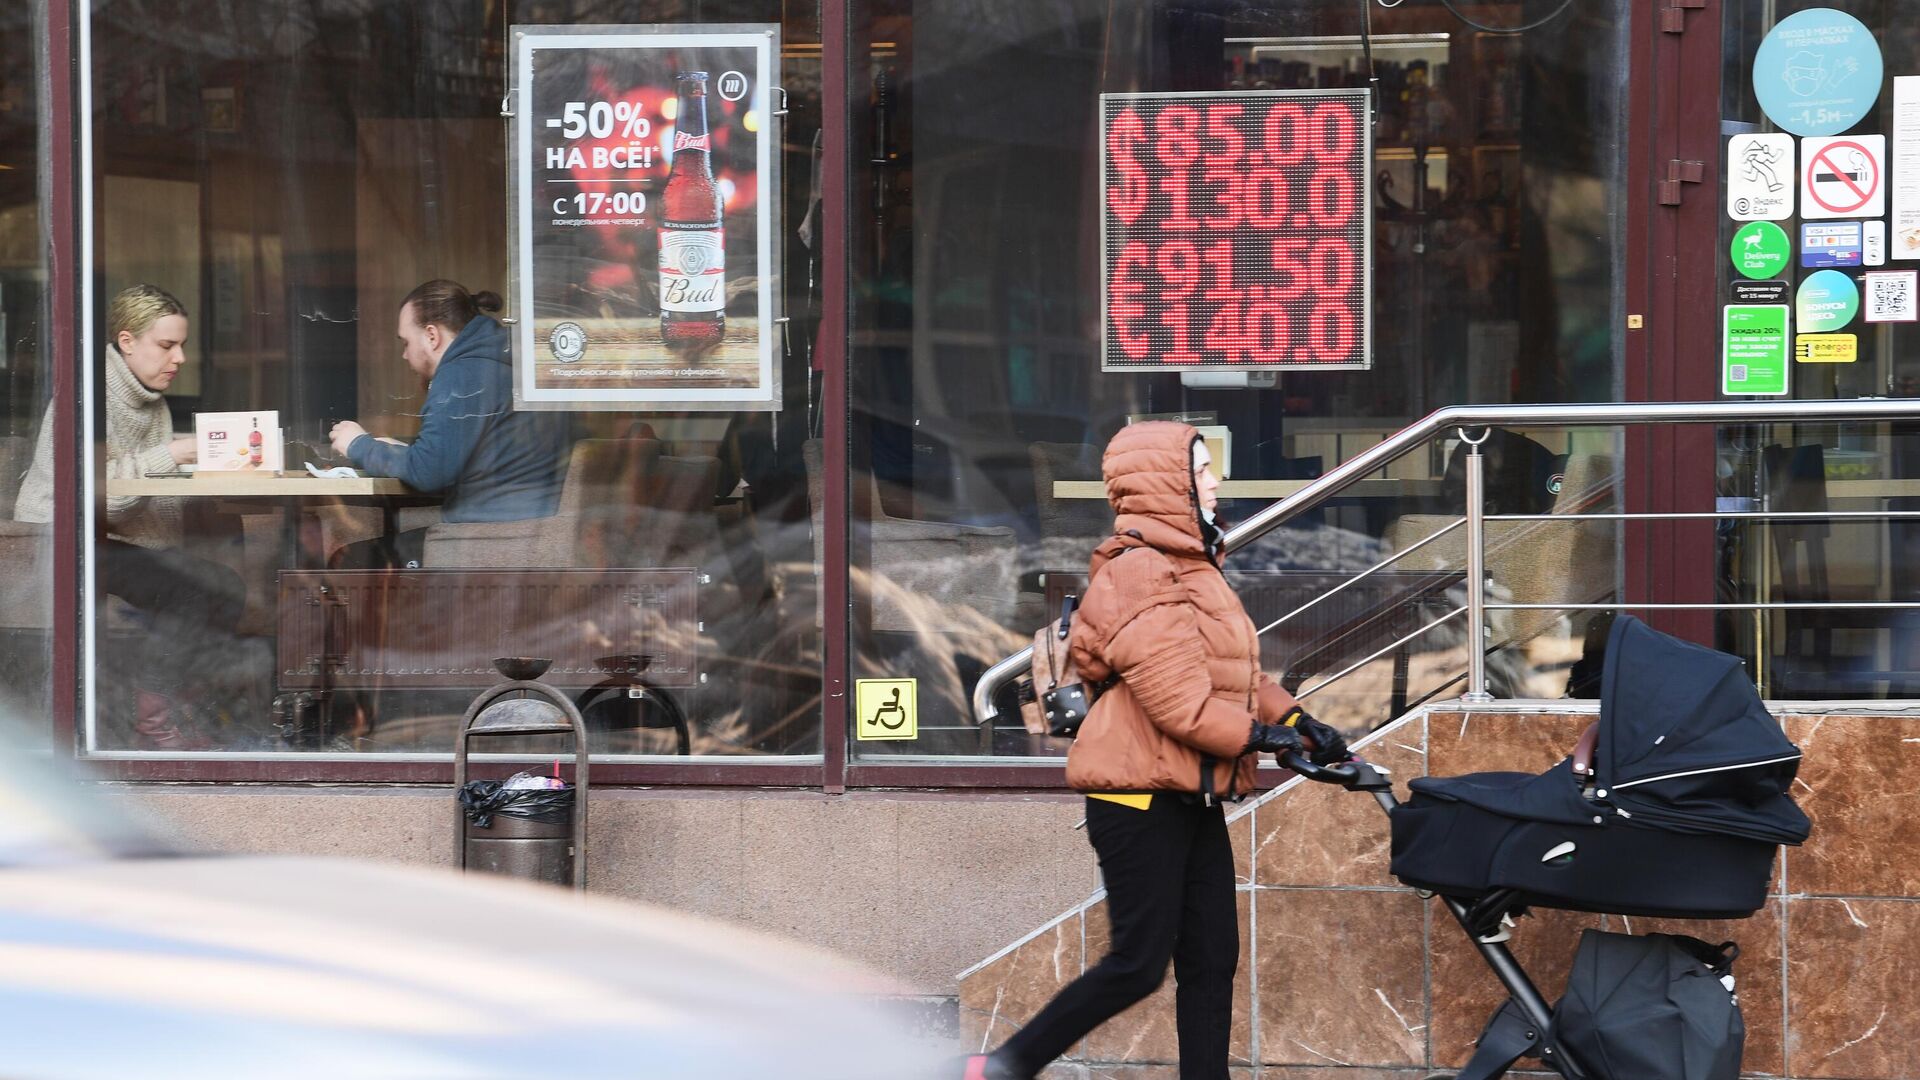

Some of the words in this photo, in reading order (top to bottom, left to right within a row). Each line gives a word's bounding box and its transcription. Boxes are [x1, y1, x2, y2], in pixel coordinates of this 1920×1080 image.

[546, 101, 651, 139] -50%
[1155, 103, 1356, 166] 85.00
[546, 147, 587, 169] НА
[574, 192, 646, 214] 17:00
[1159, 167, 1356, 229] 130.0
[1744, 252, 1780, 261] Delivery
[1744, 260, 1765, 268] Club
[663, 277, 719, 304] Bud
[1109, 240, 1149, 360] €
[1156, 237, 1356, 300] 91.50
[1160, 301, 1356, 363] 140.0
